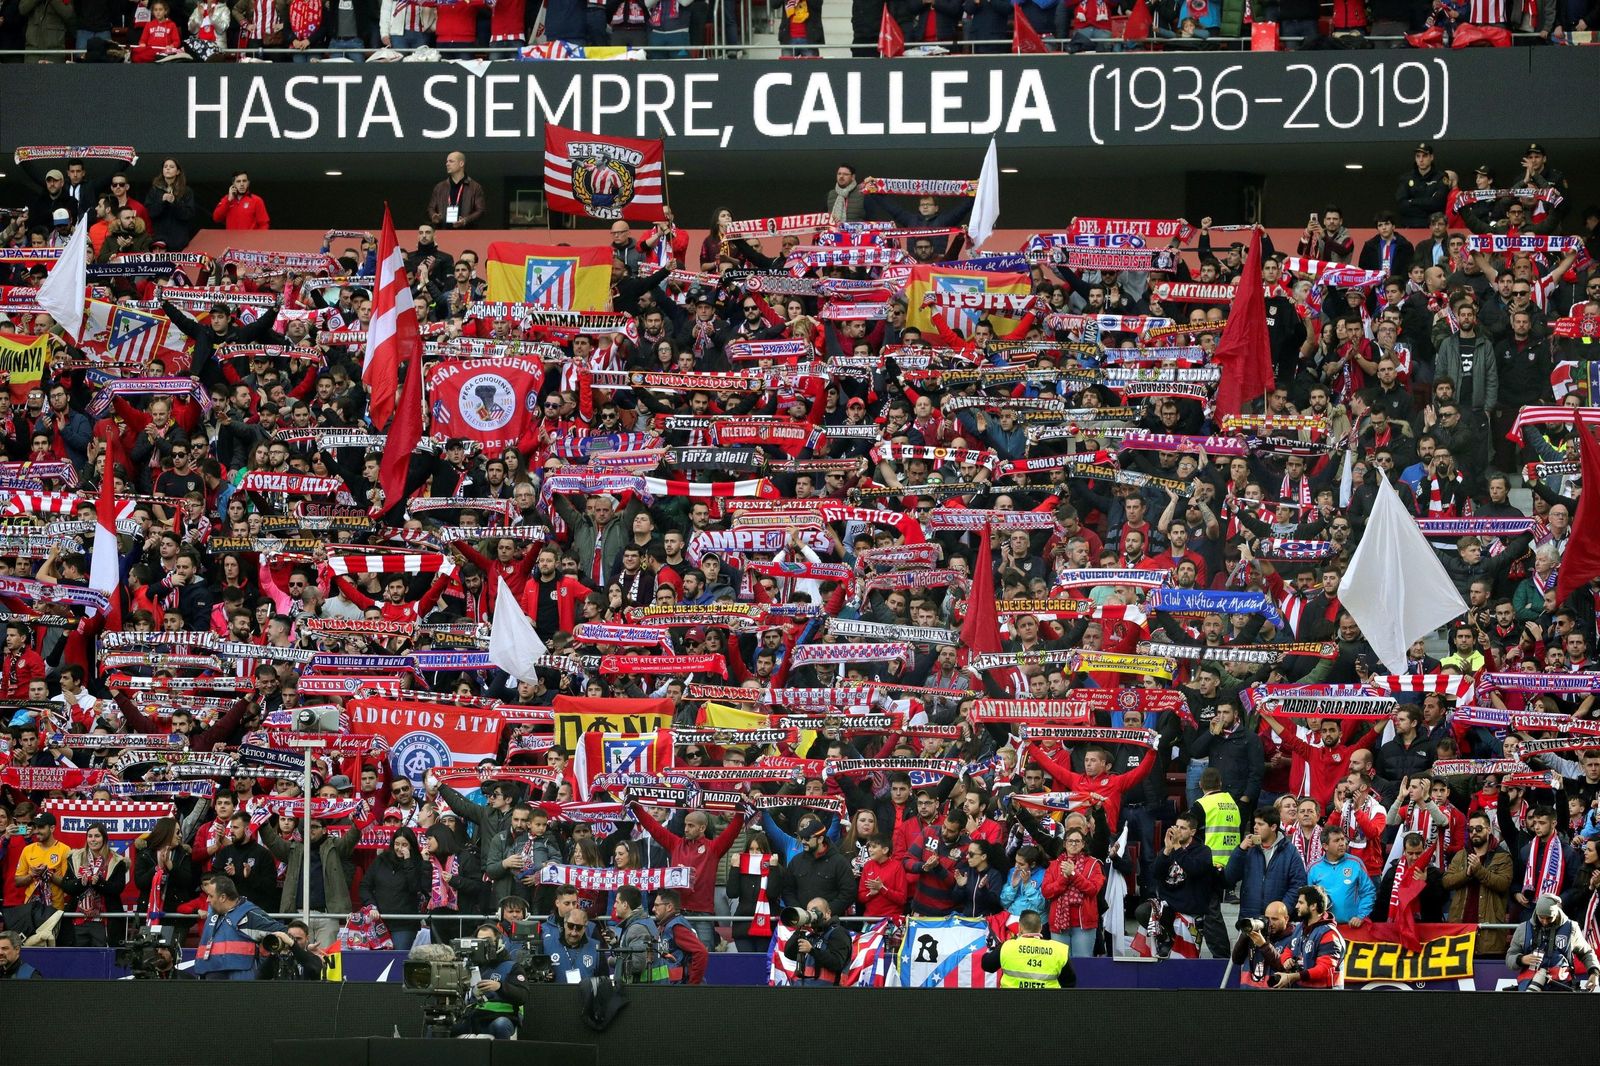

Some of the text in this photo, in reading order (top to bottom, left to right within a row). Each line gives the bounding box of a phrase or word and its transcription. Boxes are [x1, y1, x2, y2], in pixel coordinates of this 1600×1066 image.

[188, 75, 404, 140] HASTA
[422, 73, 734, 148] SIEMPRE,
[752, 69, 1057, 137] CALLEJA
[1078, 220, 1180, 235] DEL ATLETI SOY
[1471, 236, 1545, 249] TE QUIERO
[1069, 252, 1152, 266] ANTIMADRIDISTA
[226, 292, 273, 304] PRESENTES
[531, 312, 629, 329] ANTIMADRIDISTA
[462, 357, 542, 381] CONQUENSE
[645, 374, 747, 389] ANTIMADRIDISTA
[665, 416, 710, 430] Frente
[721, 427, 806, 440] ATLETICO MADRID
[682, 451, 750, 465] Forza atleti!
[1027, 459, 1055, 471] CHOLO
[247, 473, 288, 490] FORZA
[728, 500, 772, 511] FRENTE
[824, 507, 903, 526] ATLETICO
[946, 512, 1053, 526] FRENTE ATLETICO
[1492, 520, 1536, 532] MADRID
[912, 574, 944, 587] Madrid
[1064, 571, 1116, 583] TE QUIERO
[1003, 599, 1078, 612] DEJES DE CREER
[1216, 596, 1228, 610] de
[644, 605, 675, 617] NUNCA
[721, 604, 750, 615] CREER
[307, 618, 414, 635] ANTIMADRIDISTA
[1150, 643, 1196, 661] FRENTE
[314, 656, 406, 666] Club Atlético de Madrid
[620, 656, 638, 664] CLUB
[676, 656, 687, 665] DE
[978, 700, 1088, 719] ANTIMADRIDISTA
[1281, 700, 1343, 714] MADRID SOLO
[353, 706, 501, 734] ADICTOS ATM
[841, 715, 892, 729] Atlético
[1514, 713, 1558, 728] FRENTE
[732, 730, 786, 744] Atlético
[1099, 728, 1119, 740] NOS
[1119, 729, 1147, 742] NADIE
[333, 736, 371, 749] Madrid
[836, 759, 954, 774] NADIE NOS DE TI
[703, 768, 788, 780] NOS DE TI
[629, 787, 742, 804] ATLETICO MADRID
[766, 796, 785, 807] NOS
[925, 835, 939, 851] 16
[571, 871, 661, 889] Fernando Torres
[1018, 945, 1054, 956] SEGURIDAD
[1346, 933, 1473, 981] ECHES
[1026, 958, 1043, 969] 434
